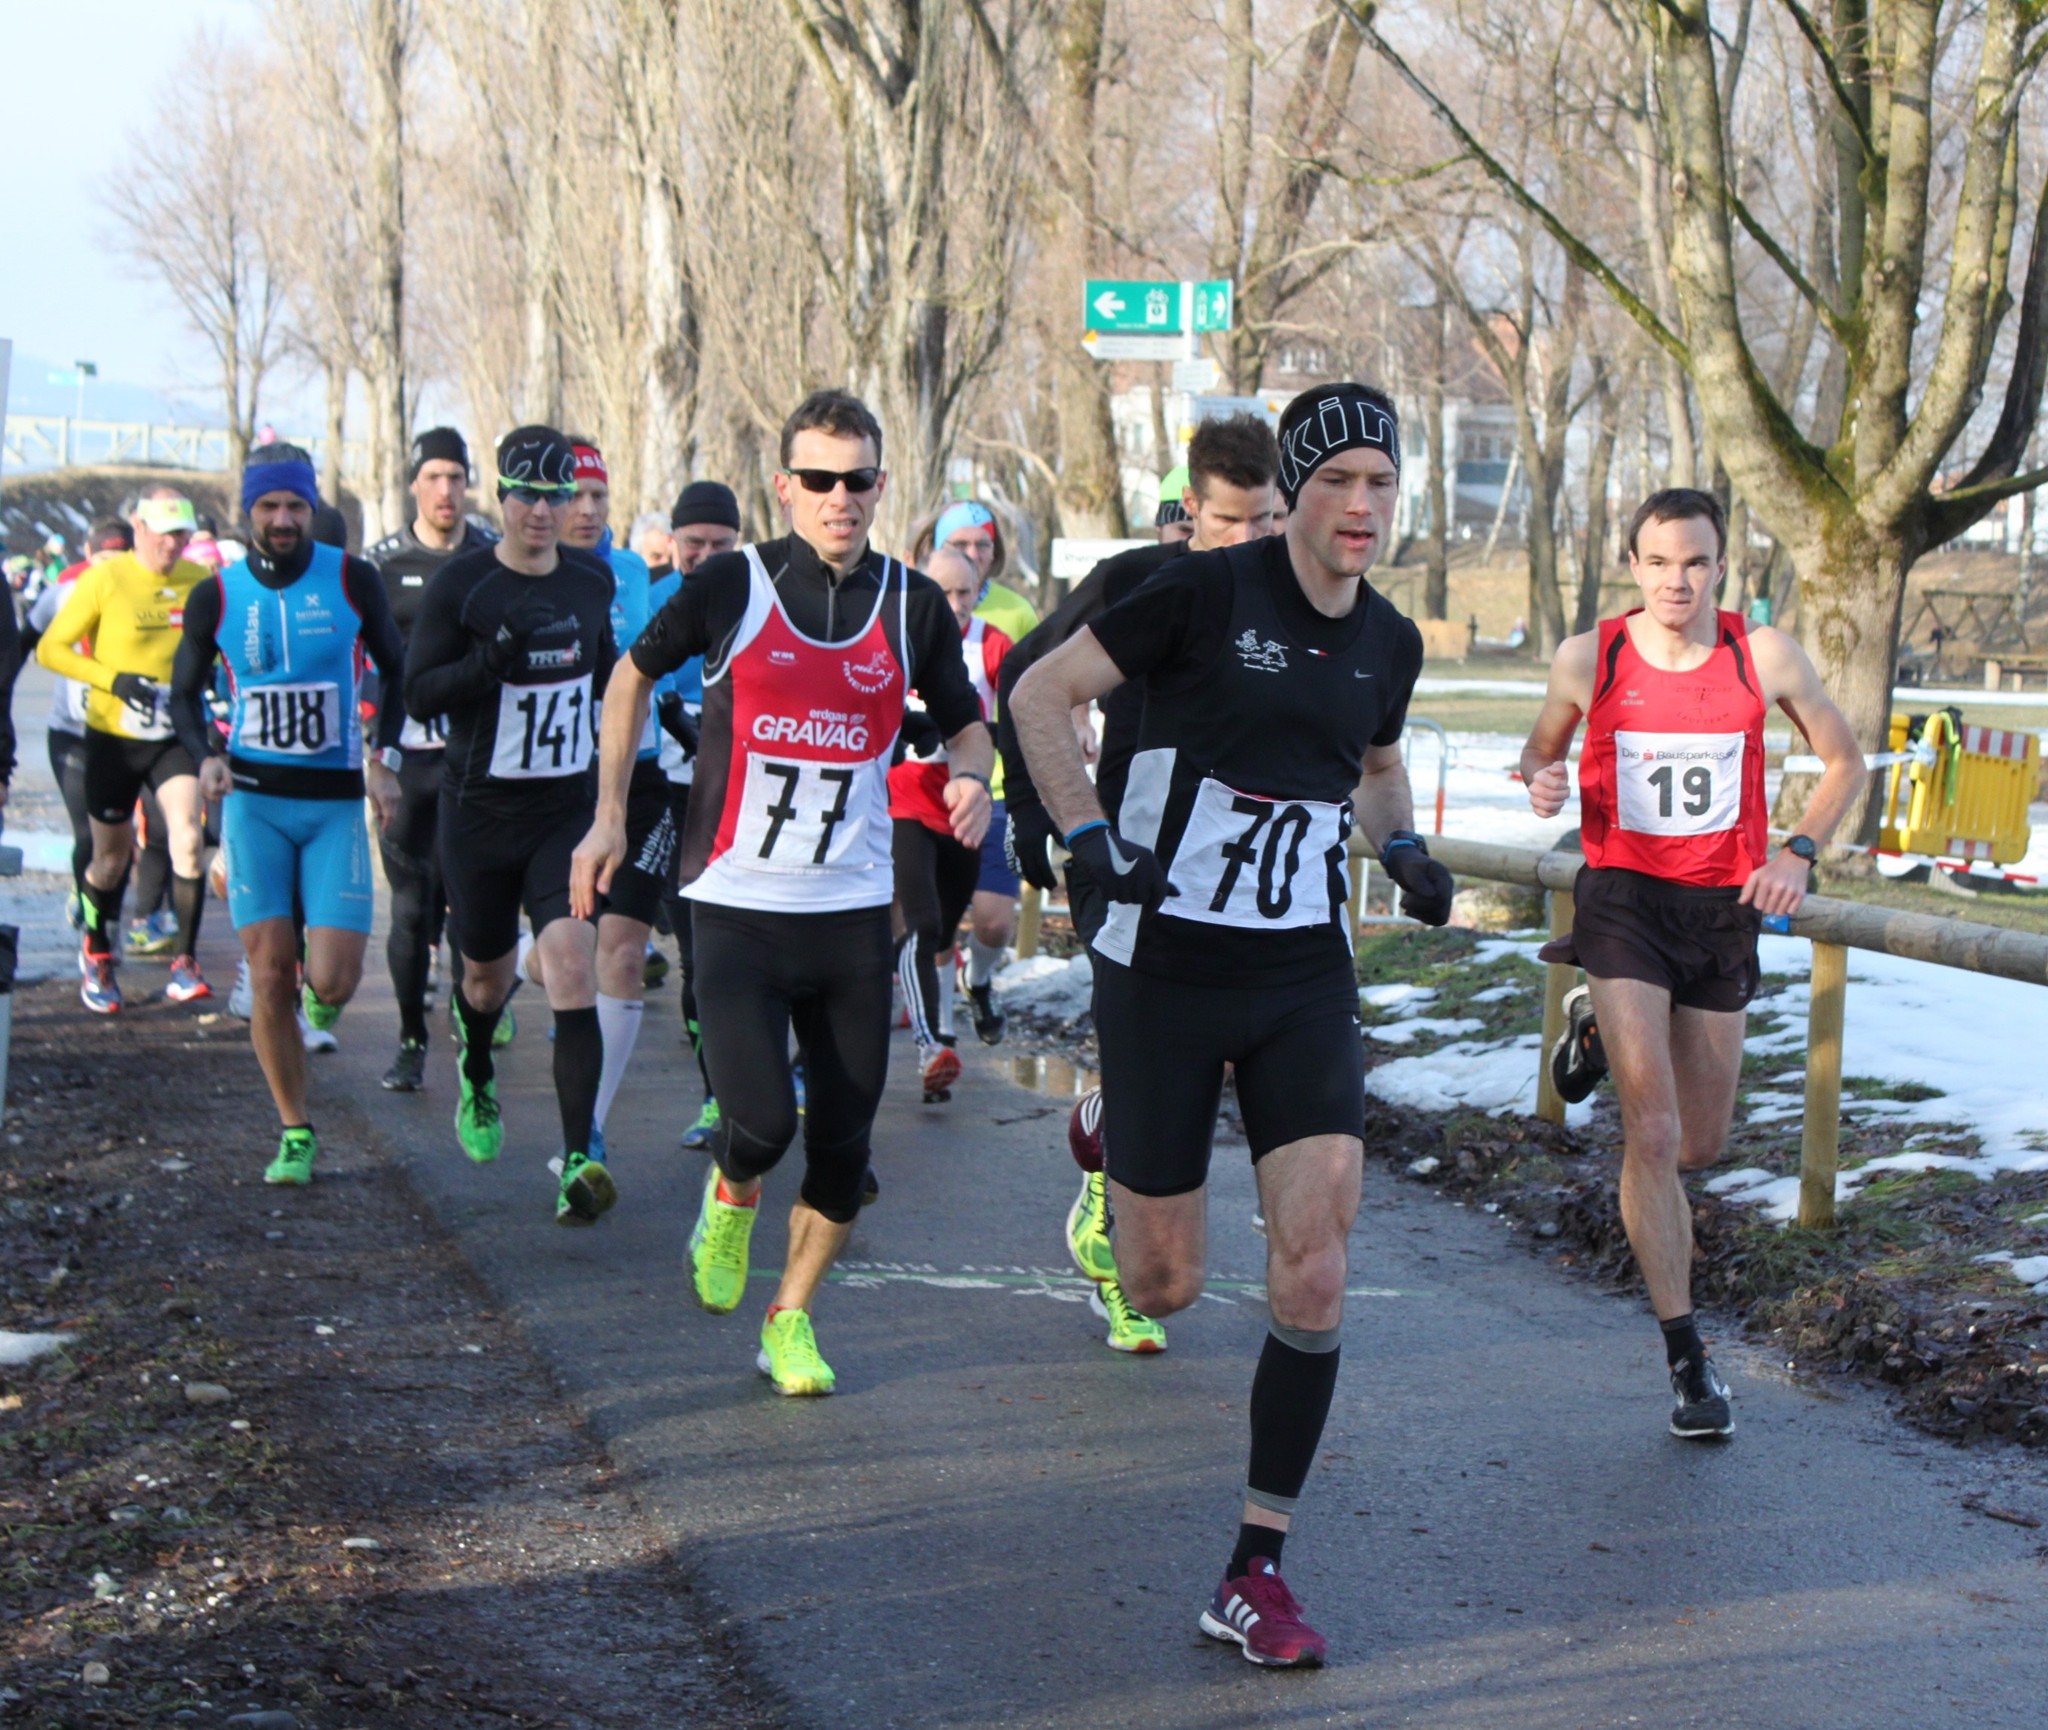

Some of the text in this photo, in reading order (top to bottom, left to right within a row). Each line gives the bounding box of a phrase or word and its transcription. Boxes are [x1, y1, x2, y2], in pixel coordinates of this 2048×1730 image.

[517, 686, 584, 770] 141
[752, 714, 868, 752] GRAVAG
[809, 708, 848, 723] erdgas
[1622, 747, 1737, 762] Die Bausparkasse
[758, 762, 854, 865] 77
[1647, 765, 1712, 818] 19
[1208, 795, 1312, 919] 70
